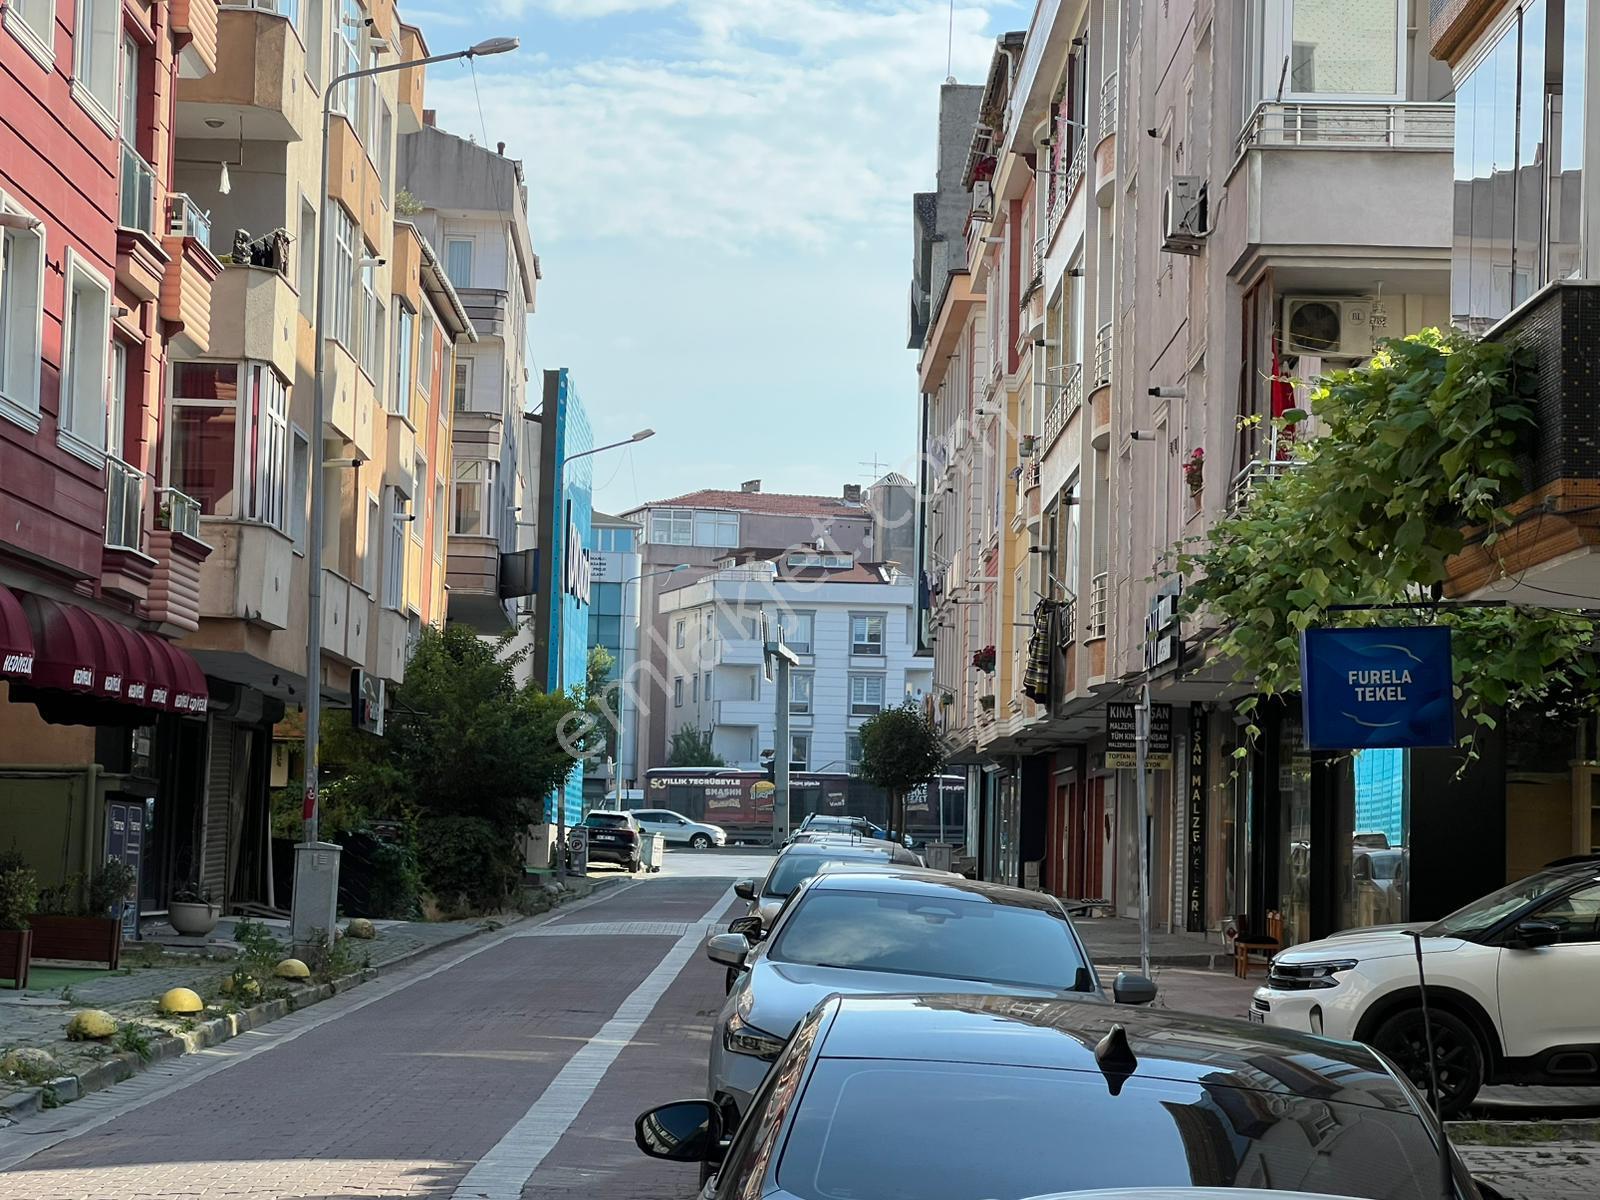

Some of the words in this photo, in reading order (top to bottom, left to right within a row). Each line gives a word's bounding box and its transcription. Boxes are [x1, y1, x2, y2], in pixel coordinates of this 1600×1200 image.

[1348, 669, 1412, 685] FURELA
[1354, 686, 1407, 702] TEKEL
[1109, 706, 1133, 718] KINA
[1151, 707, 1169, 720] ŞAN
[1111, 730, 1124, 740] TÜM
